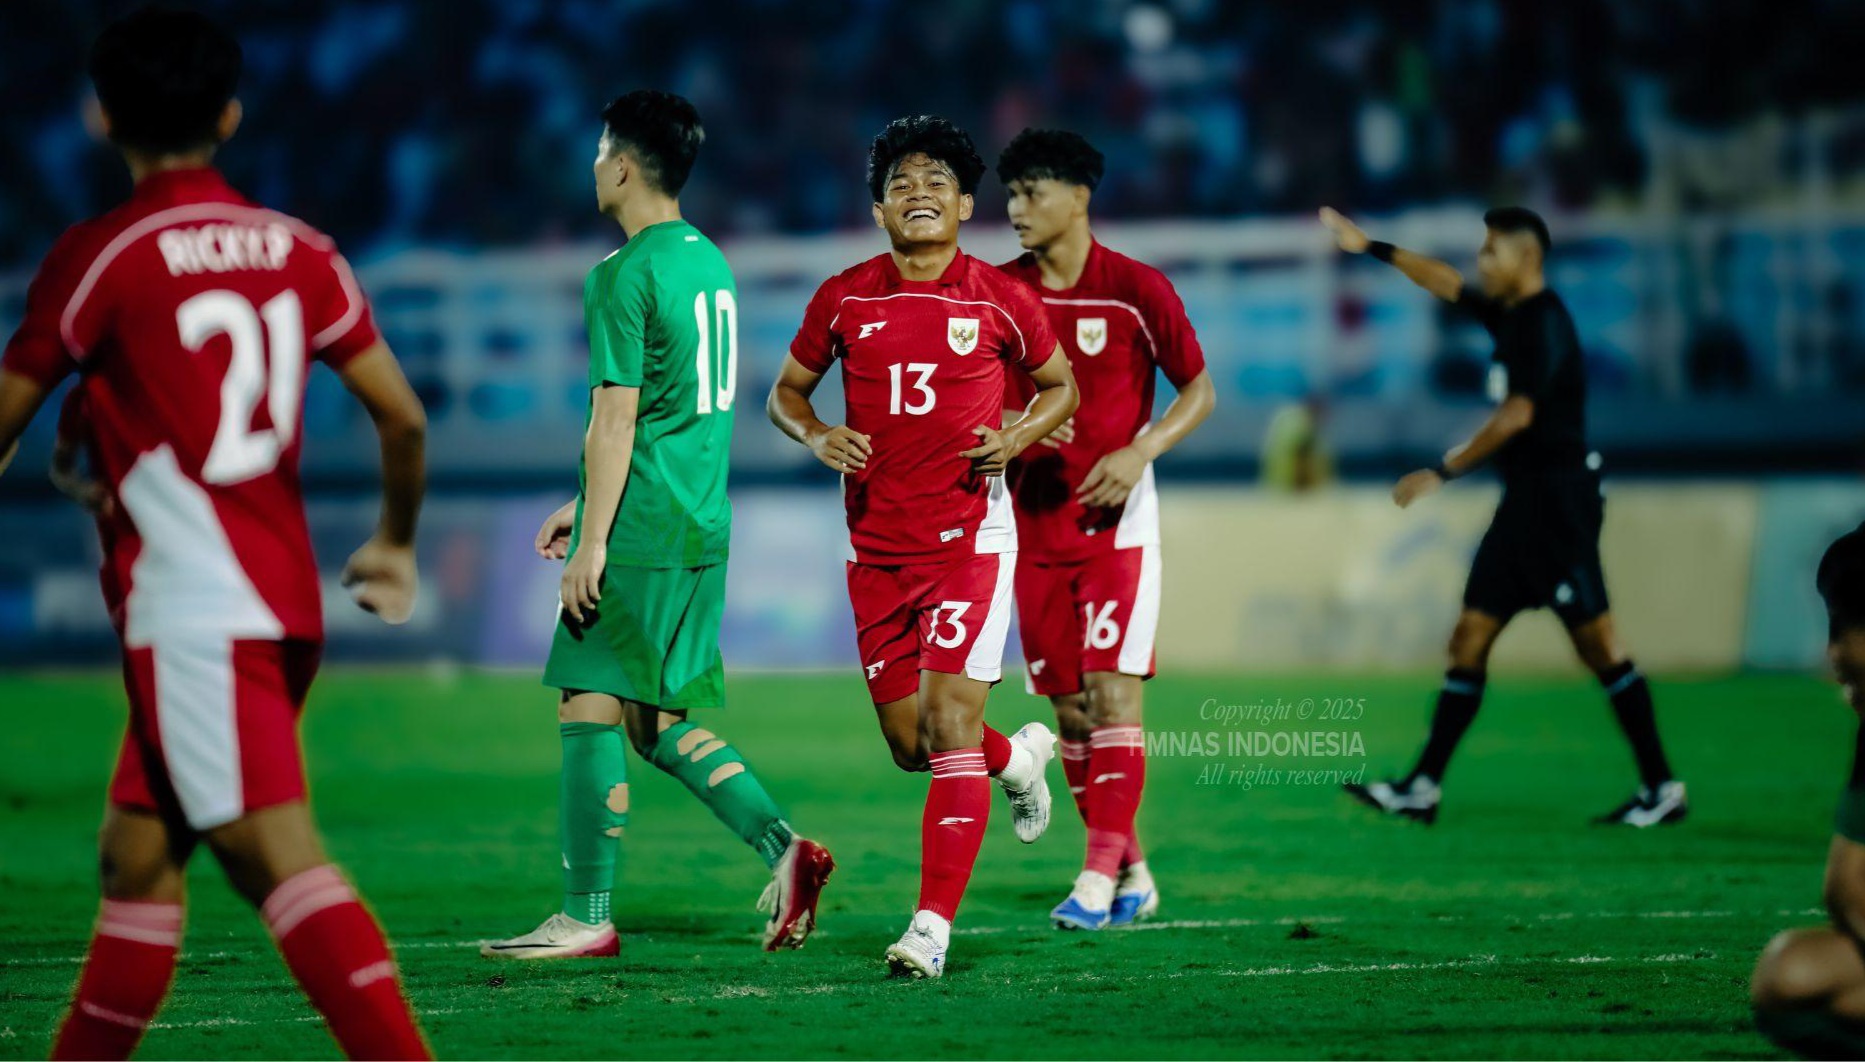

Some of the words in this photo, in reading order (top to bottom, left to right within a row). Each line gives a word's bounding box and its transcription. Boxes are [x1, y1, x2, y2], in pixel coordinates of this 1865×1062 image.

[694, 289, 738, 414] 10
[175, 287, 304, 487] 21
[887, 362, 939, 416] 13
[926, 600, 973, 649] 13
[1083, 600, 1121, 650] 16
